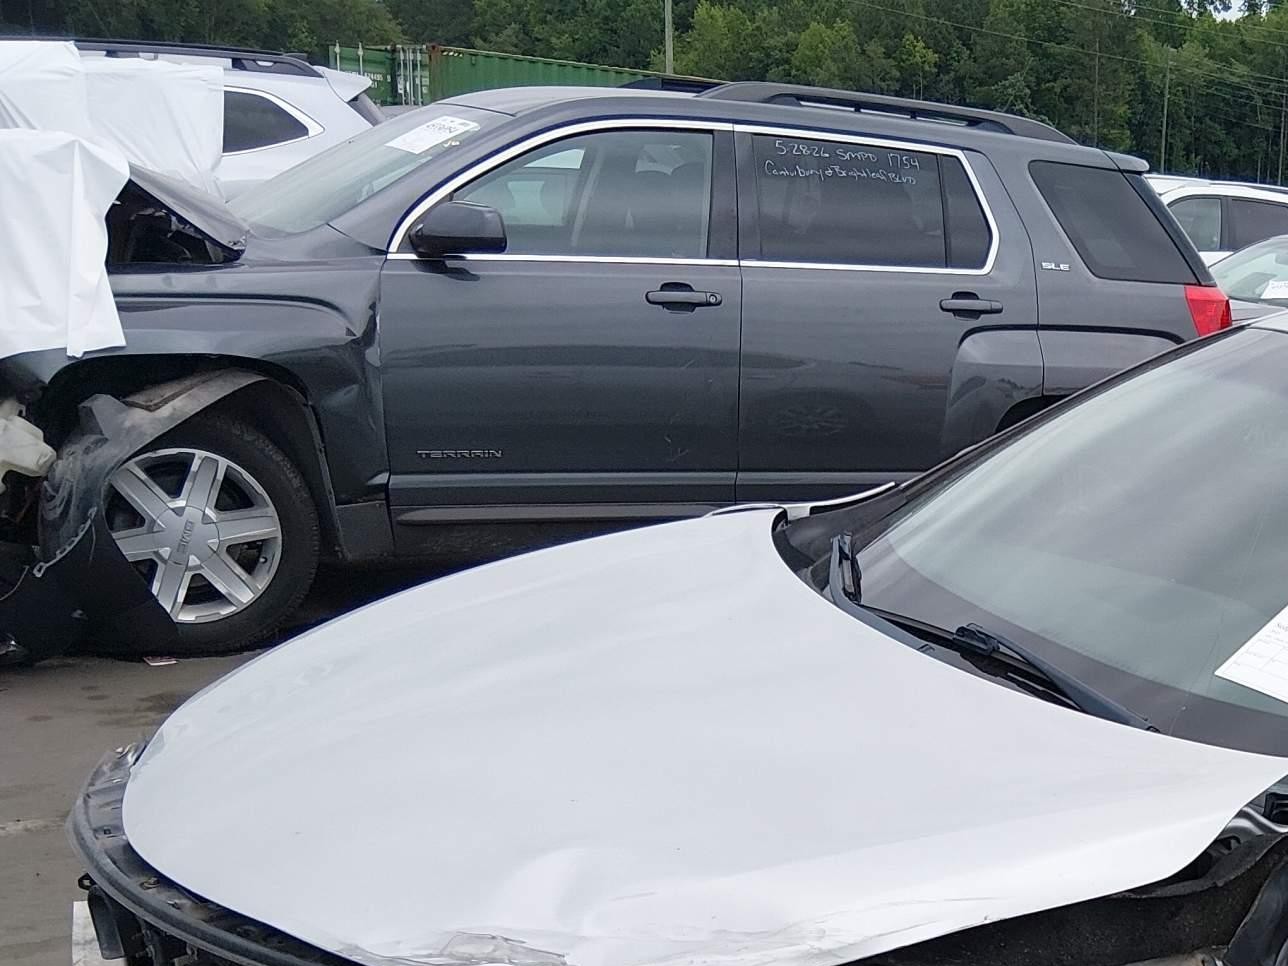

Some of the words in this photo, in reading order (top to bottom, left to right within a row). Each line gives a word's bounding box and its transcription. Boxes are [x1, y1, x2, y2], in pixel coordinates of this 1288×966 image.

[887, 153, 920, 171] 1754
[1041, 262, 1070, 270] SLE
[416, 450, 502, 458] TERRAIN
